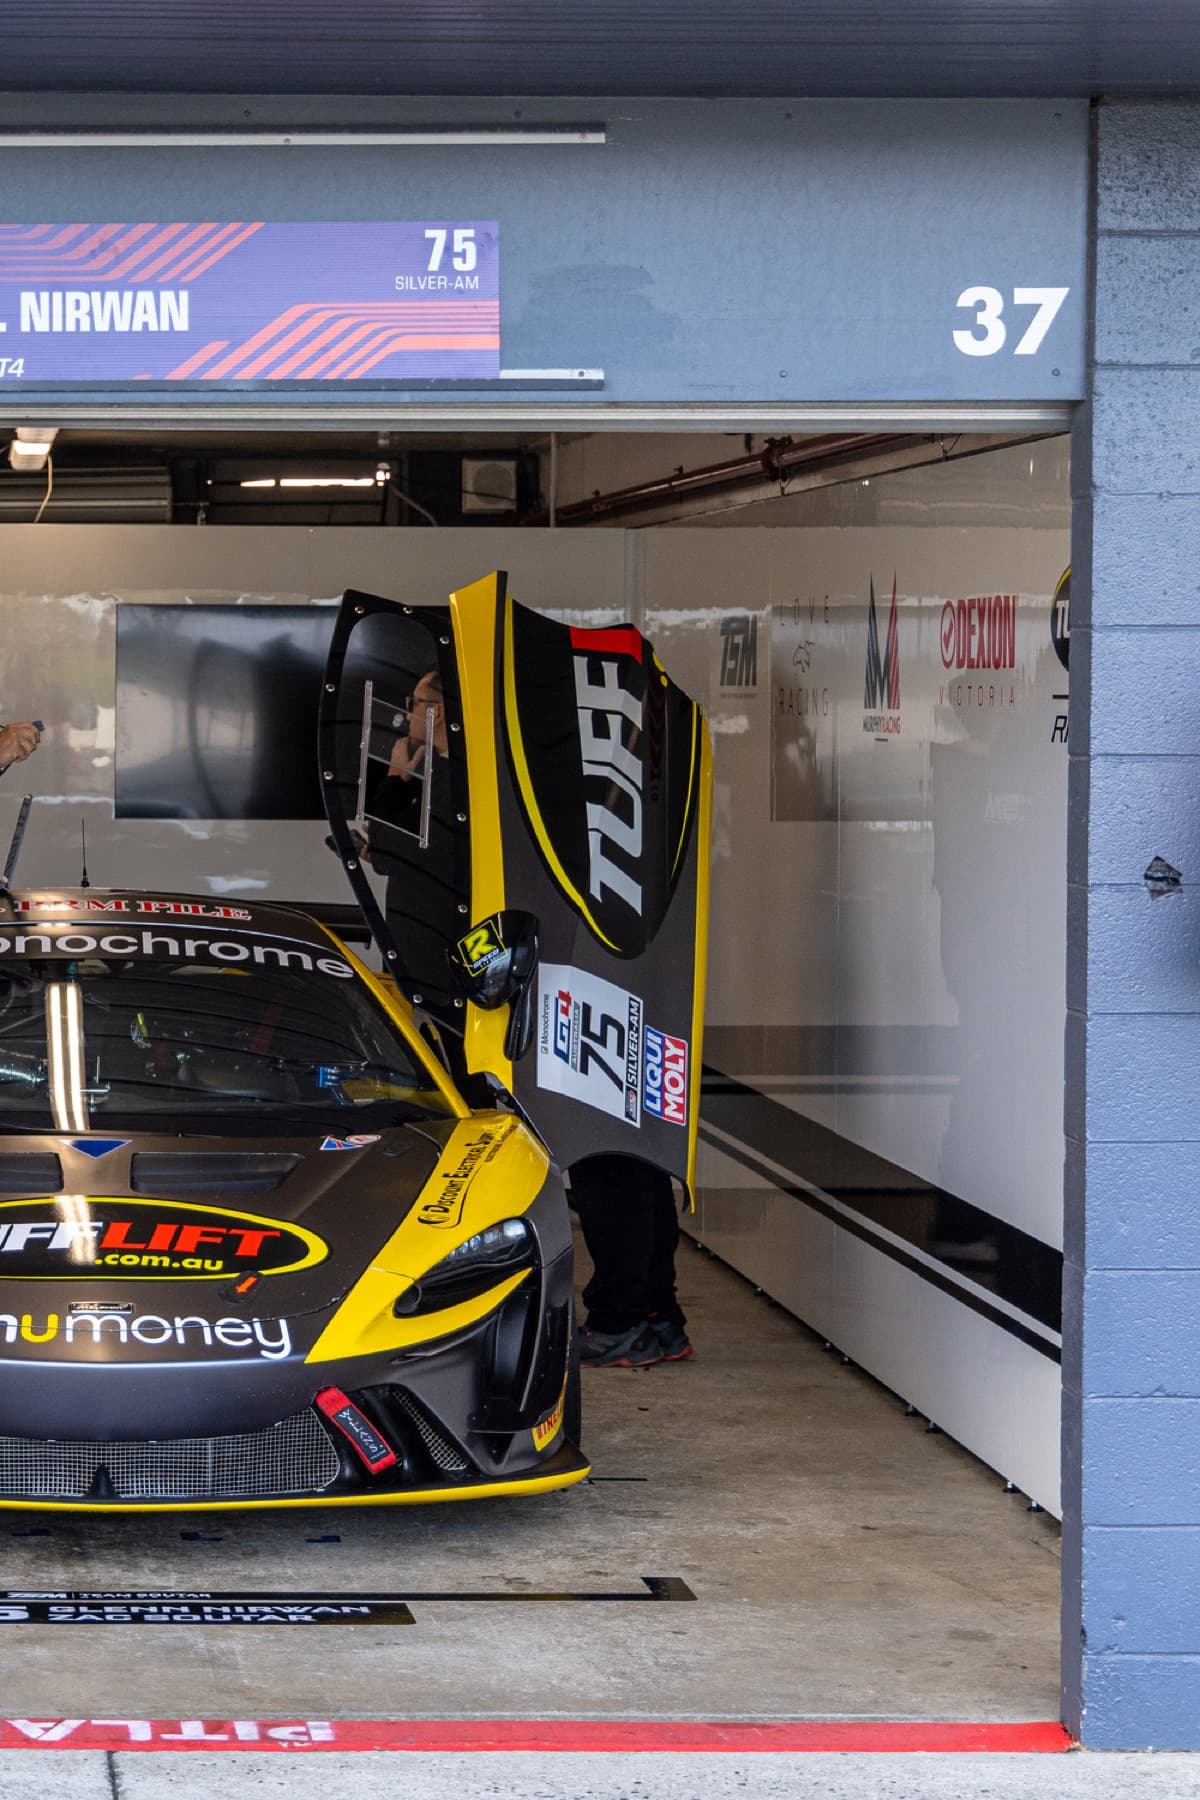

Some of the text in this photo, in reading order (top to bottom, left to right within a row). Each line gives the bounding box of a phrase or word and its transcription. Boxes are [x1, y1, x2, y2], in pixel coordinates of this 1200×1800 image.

[424, 229, 478, 272] 75
[394, 275, 480, 290] SILVER-AM
[20, 290, 190, 332] NIRWAN
[951, 285, 1071, 357] 37
[719, 615, 758, 687] TSM
[956, 594, 1017, 669] DEXION
[136, 899, 253, 921] PILE
[540, 993, 549, 1044] Monochrome
[627, 1000, 640, 1085] SILVER-AM
[579, 1000, 626, 1093] 75
[644, 1030, 663, 1112] LIQUI
[664, 1037, 685, 1119] MOLY
[94, 1252, 224, 1272] .com.au
[48, 1614, 317, 1622] ZAC SOUTAR
[202, 1606, 371, 1614] NIRWAN
